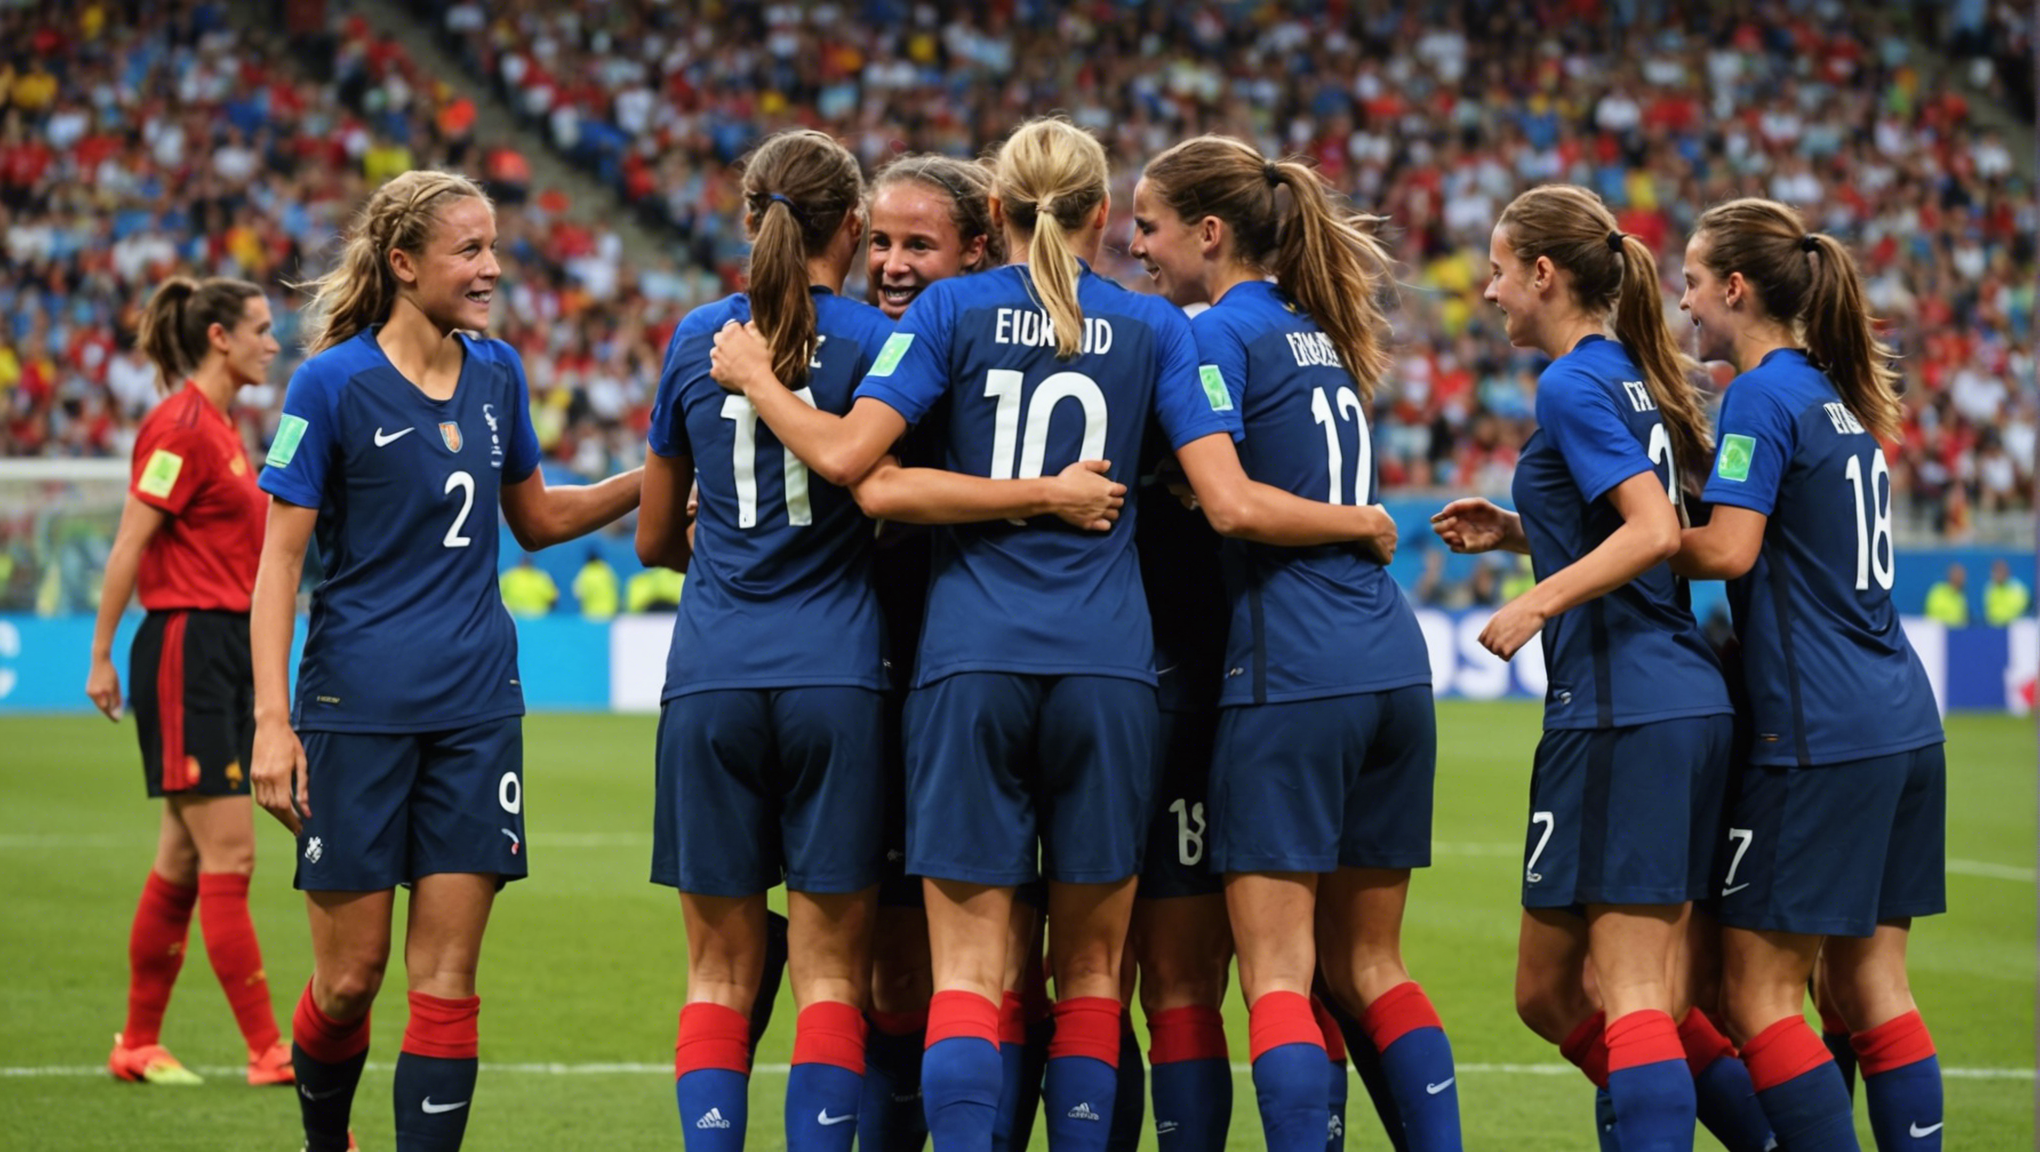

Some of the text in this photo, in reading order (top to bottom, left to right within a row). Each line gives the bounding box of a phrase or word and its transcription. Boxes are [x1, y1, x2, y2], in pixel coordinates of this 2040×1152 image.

[720, 386, 818, 529] 11
[984, 369, 1108, 480] 10
[443, 471, 475, 548] 2
[1846, 448, 1895, 591] 18
[1728, 828, 1753, 886] 7
